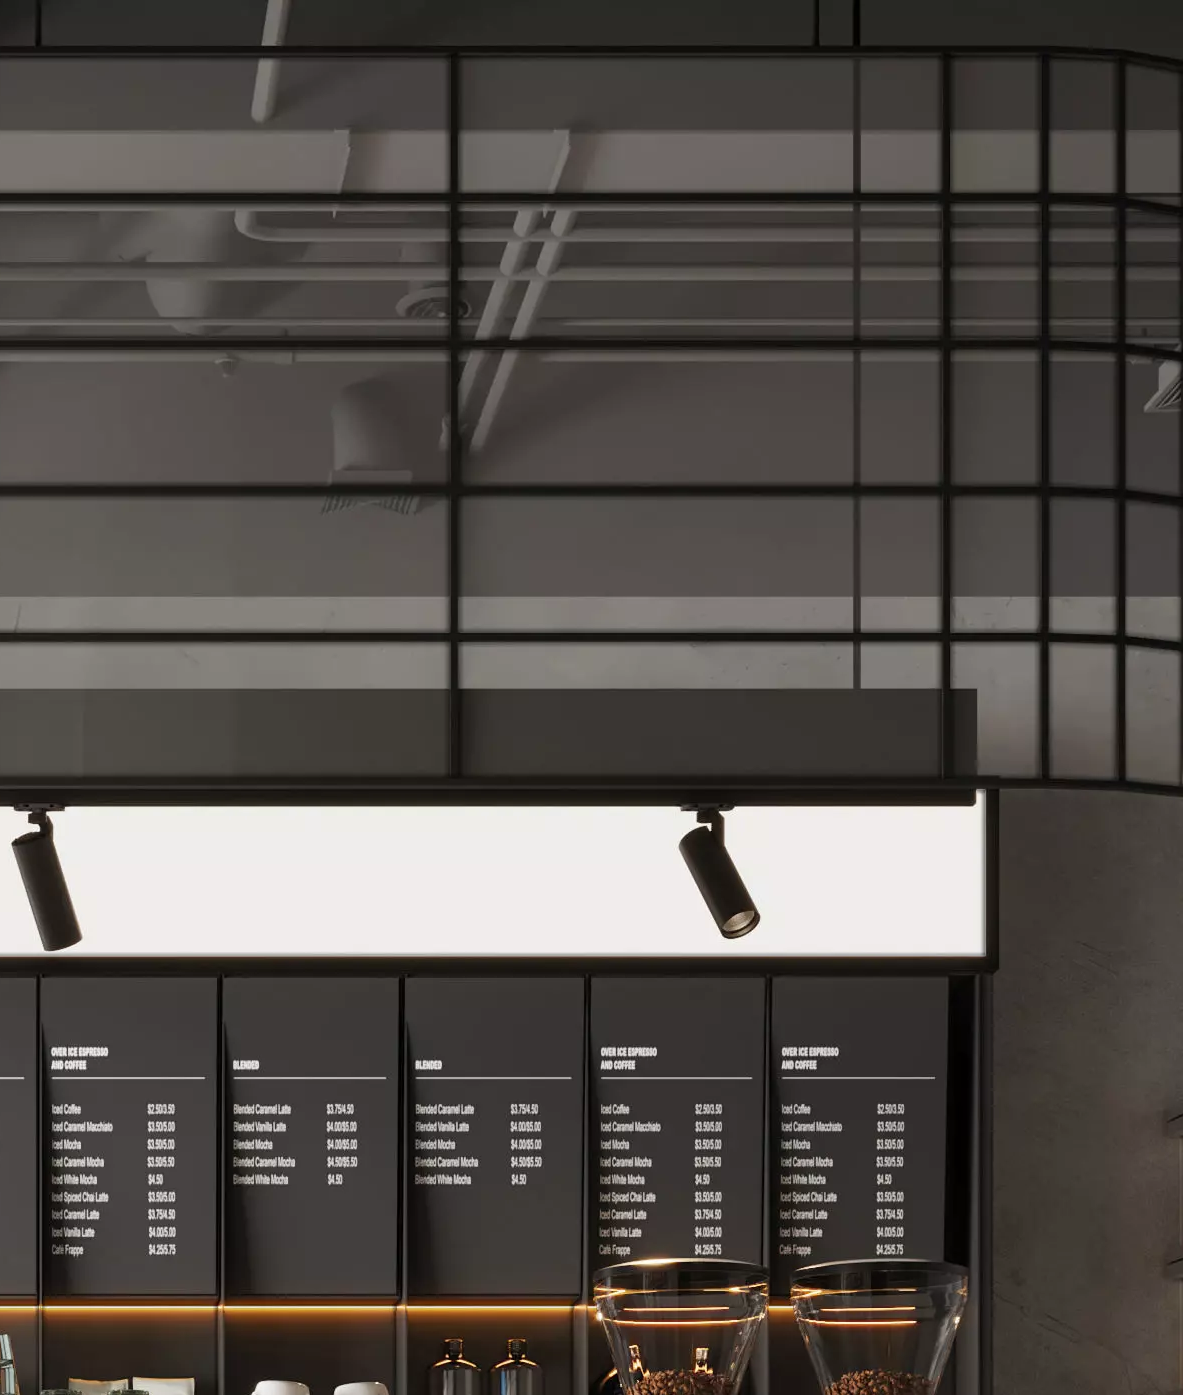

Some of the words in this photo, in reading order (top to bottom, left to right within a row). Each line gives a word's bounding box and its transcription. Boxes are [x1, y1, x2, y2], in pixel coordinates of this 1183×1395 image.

[51, 1047, 67, 1056] OVER
[68, 1047, 77, 1057] ICE
[79, 1047, 109, 1056] ESPRESSO
[601, 1047, 616, 1056] OVER
[617, 1047, 627, 1056] ICE
[628, 1047, 657, 1056] ESPRESSO
[781, 1047, 797, 1056] OVER
[798, 1047, 808, 1056] ICE
[809, 1047, 839, 1056] ESPRESSO
[51, 1060, 63, 1070] AND
[65, 1060, 87, 1070] COFFEE
[233, 1060, 259, 1070] BLENDED
[415, 1060, 442, 1070] BLENDED
[601, 1060, 613, 1070] AND
[614, 1060, 635, 1070] COFFEE
[781, 1060, 793, 1070] AND
[795, 1060, 817, 1070] COFFEE
[52, 1104, 63, 1114] Iced
[64, 1104, 81, 1114] Coffee
[415, 1104, 437, 1114] Blended
[438, 1104, 460, 1114] Caramel
[461, 1104, 474, 1114] Latte
[781, 1104, 792, 1114] Iced
[794, 1104, 811, 1114] Coffee
[52, 1122, 63, 1132] Iced
[64, 1122, 85, 1132] Caramel
[87, 1122, 113, 1132] Macchiato
[415, 1122, 437, 1132] Blended
[438, 1122, 455, 1132] Vanilla
[456, 1122, 469, 1132] Latte
[781, 1122, 792, 1132] Iced
[793, 1122, 815, 1132] Caramel
[816, 1122, 842, 1132] Macchiato
[52, 1140, 63, 1150] Iced
[64, 1139, 81, 1150] Mocha
[415, 1139, 437, 1150] Blended
[438, 1139, 455, 1150] Mocha
[781, 1140, 791, 1150] Iced
[793, 1139, 811, 1150] Mocha
[52, 1157, 63, 1167] Iced
[64, 1157, 85, 1167] Caramel
[87, 1157, 104, 1167] Mocha
[415, 1157, 436, 1167] Blended
[438, 1157, 459, 1167] Caramel
[461, 1157, 479, 1167] Mocha
[781, 1157, 791, 1167] Iced
[793, 1157, 814, 1167] Caramel
[816, 1157, 833, 1167] Mocha
[52, 1175, 63, 1184] Iced
[64, 1174, 78, 1184] White
[80, 1174, 97, 1184] Mocha
[148, 1174, 163, 1185] $4.50
[415, 1174, 436, 1184] Blended
[437, 1174, 452, 1184] White
[453, 1174, 471, 1184] Mocha
[781, 1174, 791, 1184] Iced
[793, 1174, 807, 1184] White
[809, 1174, 826, 1184] Mocha
[877, 1174, 892, 1184] $4.50
[52, 1192, 63, 1202] Iced
[64, 1192, 81, 1203] Spiced
[83, 1192, 94, 1202] Chai
[95, 1192, 109, 1202] Latte
[781, 1192, 791, 1202] Iced
[793, 1192, 809, 1203] Spiced
[811, 1192, 823, 1202] Chai
[824, 1192, 837, 1202] Latte
[52, 1210, 63, 1220] Iced
[64, 1209, 85, 1220] Caramel
[87, 1210, 99, 1220] Latte
[780, 1210, 791, 1219] Iced
[792, 1209, 813, 1220] Caramel
[815, 1210, 828, 1220] Latte
[52, 1228, 63, 1237] Iced
[64, 1227, 80, 1237] Vanilla
[82, 1228, 95, 1237] Latte
[780, 1228, 790, 1237] Iced
[792, 1227, 808, 1237] Vanilla
[809, 1228, 823, 1237] Latte
[65, 1244, 83, 1256] Frappe
[793, 1244, 811, 1256] Frappe
